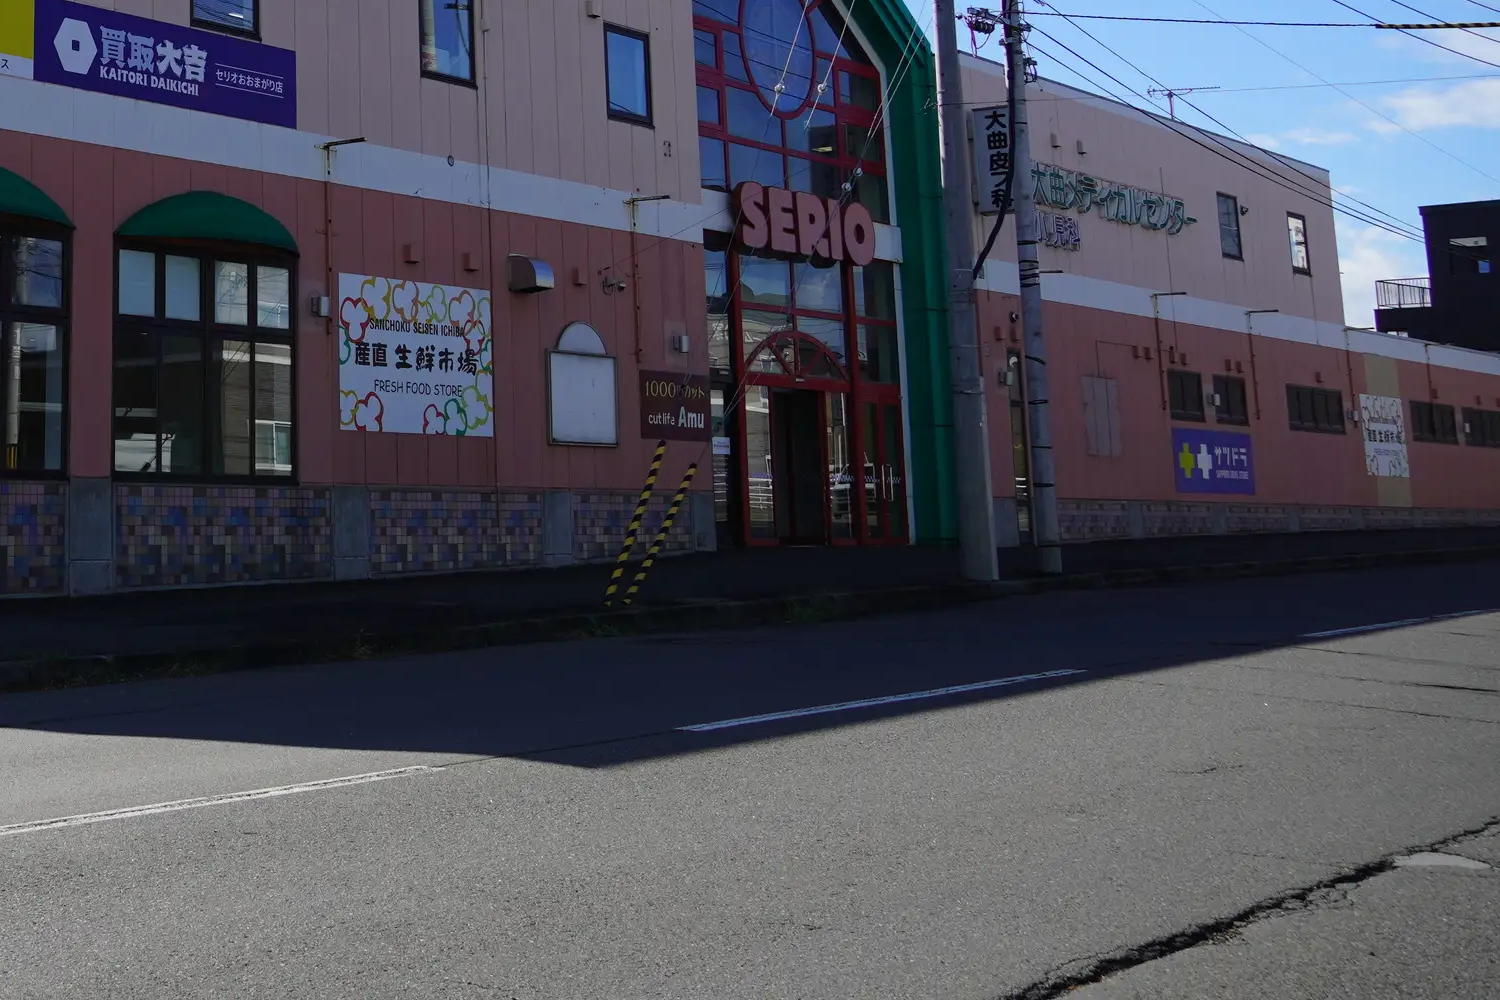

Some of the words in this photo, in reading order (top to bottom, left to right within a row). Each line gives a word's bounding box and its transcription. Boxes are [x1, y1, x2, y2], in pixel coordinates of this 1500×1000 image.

[100, 25, 208, 84] 買取大吉
[100, 65, 148, 86] KAITORI
[151, 75, 199, 96] DAIKICHI
[215, 68, 284, 94] セリオおおまがり店
[740, 181, 876, 266] SERIO
[369, 318, 411, 333] SANCHOKU
[413, 323, 439, 336] SEISEN
[441, 327, 465, 338] ICHIBA
[374, 379, 403, 393] FRESH
[406, 382, 431, 396] FOOD
[433, 384, 463, 398] STORE
[678, 406, 705, 429] Amu
